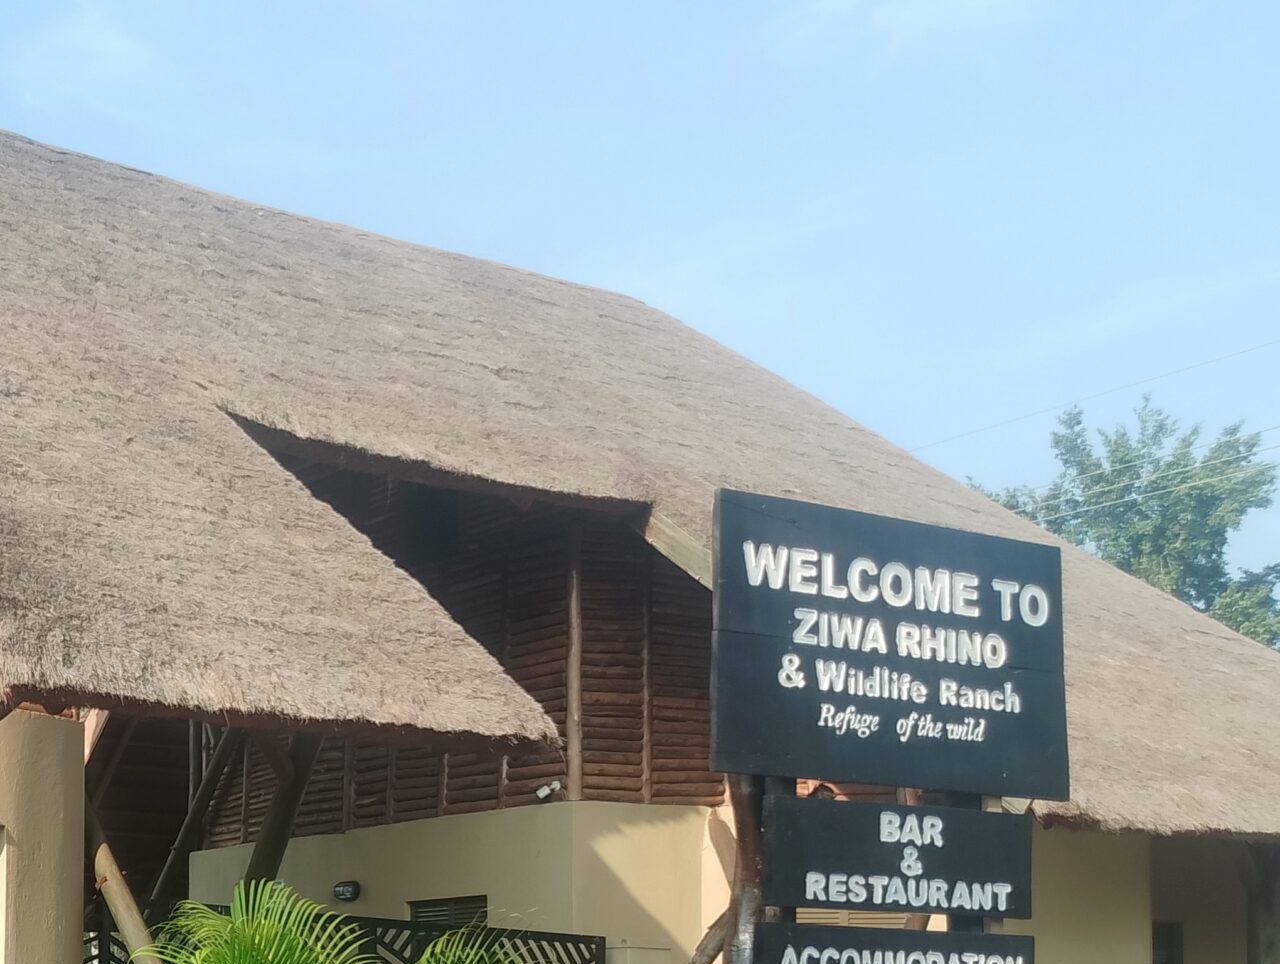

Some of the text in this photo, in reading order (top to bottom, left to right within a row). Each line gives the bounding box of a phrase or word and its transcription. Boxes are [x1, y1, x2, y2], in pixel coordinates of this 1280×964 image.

[742, 540, 1049, 628] WELCOME TO
[792, 608, 1006, 669] ZIWA RHINO
[777, 653, 1021, 713] & Wildlife Ranch
[818, 704, 986, 743] Refuge of the wild
[879, 811, 943, 848] BAR
[900, 846, 923, 876] &
[805, 872, 1012, 911] RESTAURANT
